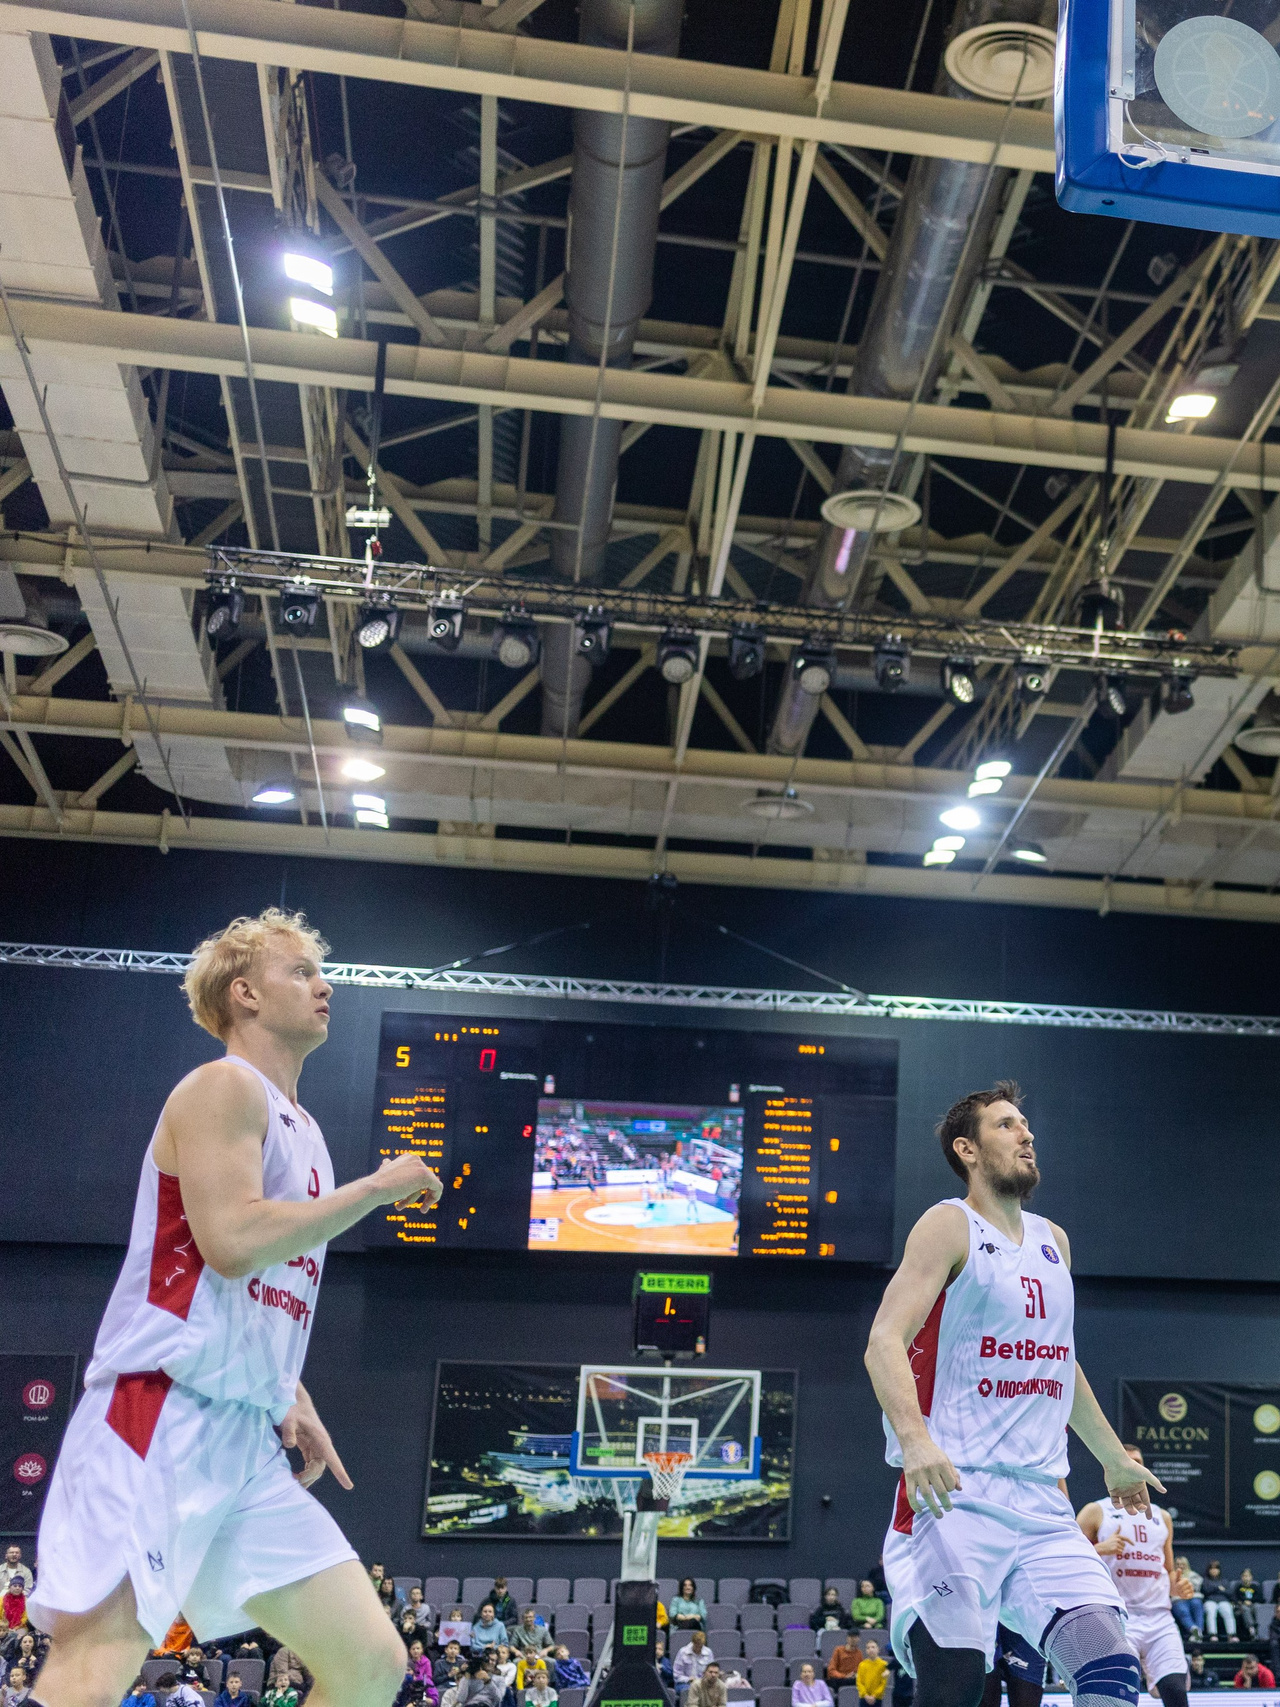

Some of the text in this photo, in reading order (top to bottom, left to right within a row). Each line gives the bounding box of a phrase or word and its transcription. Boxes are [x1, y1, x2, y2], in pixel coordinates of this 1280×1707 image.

[396, 1046, 410, 1068] 5
[1020, 1275, 1046, 1320] 31
[980, 1335, 1069, 1362] BetBoom
[1136, 1426, 1210, 1441] FALCON
[1132, 1524, 1148, 1543] 16
